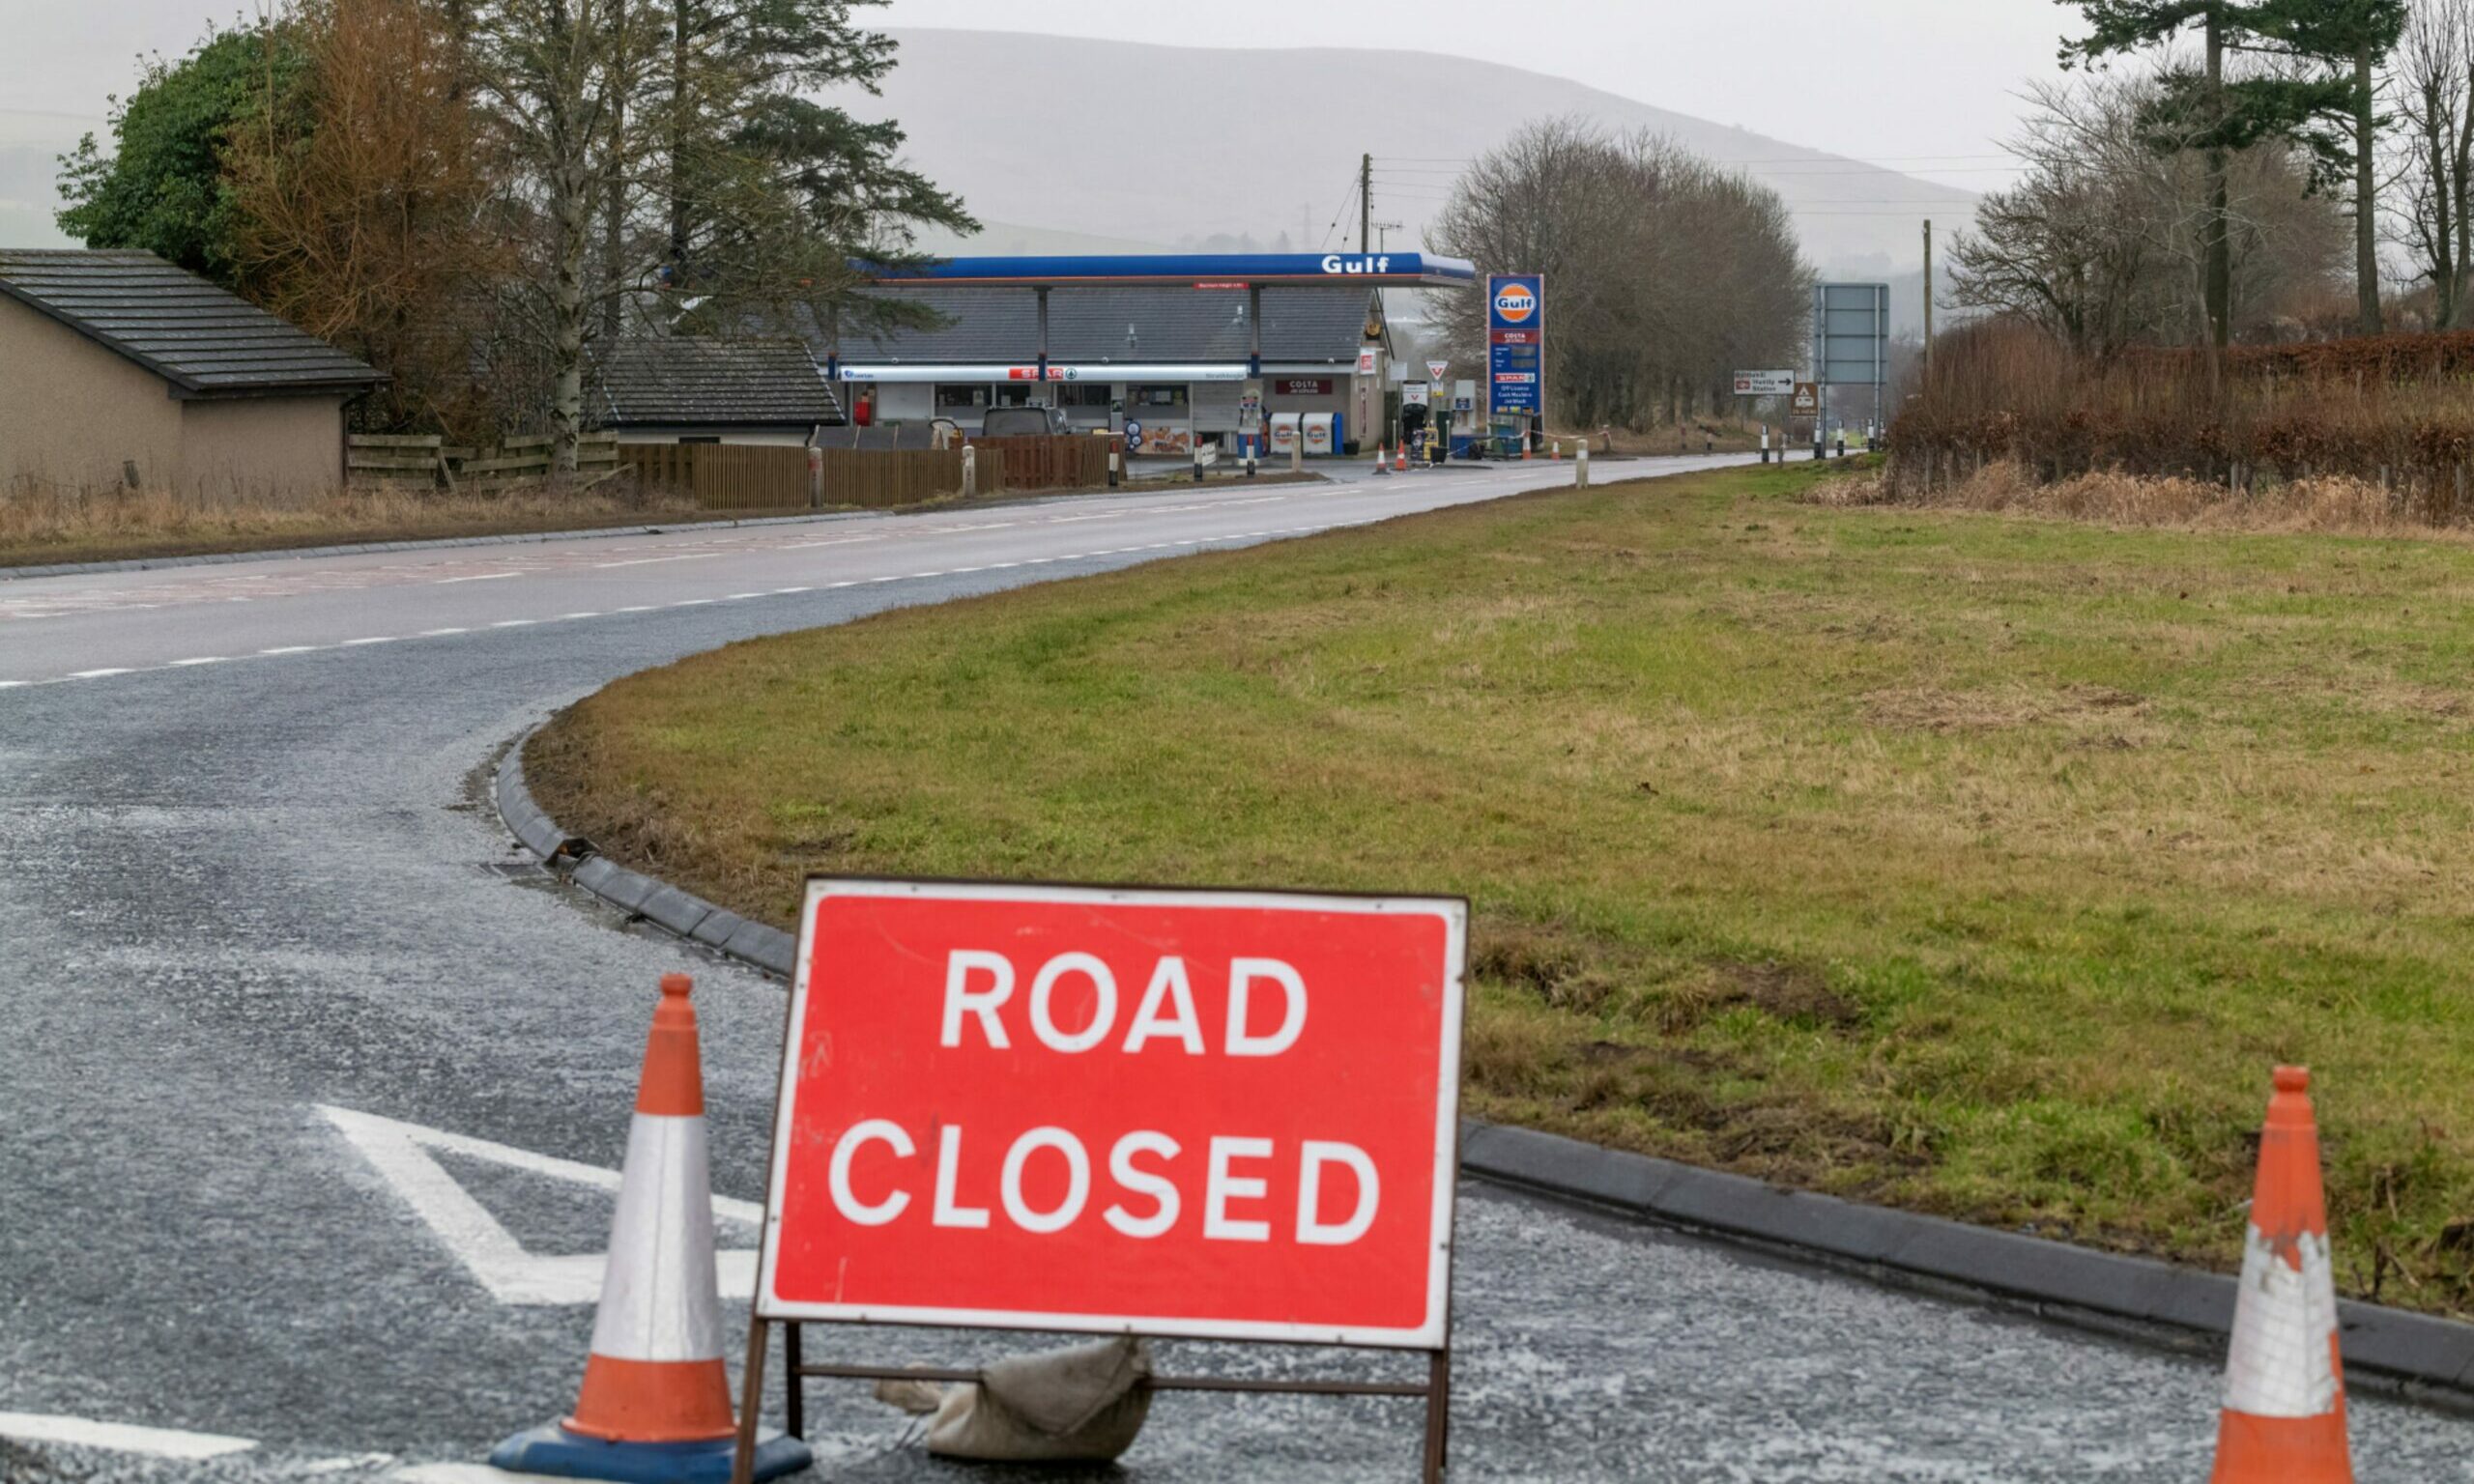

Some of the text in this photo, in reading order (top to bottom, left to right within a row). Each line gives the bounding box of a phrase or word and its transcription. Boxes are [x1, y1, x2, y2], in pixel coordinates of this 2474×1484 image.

[1322, 255, 1390, 273] Gulf
[1498, 298, 1532, 308] Gulf
[939, 950, 1309, 1057] ROAD
[828, 1120, 1380, 1244] CLOSED
